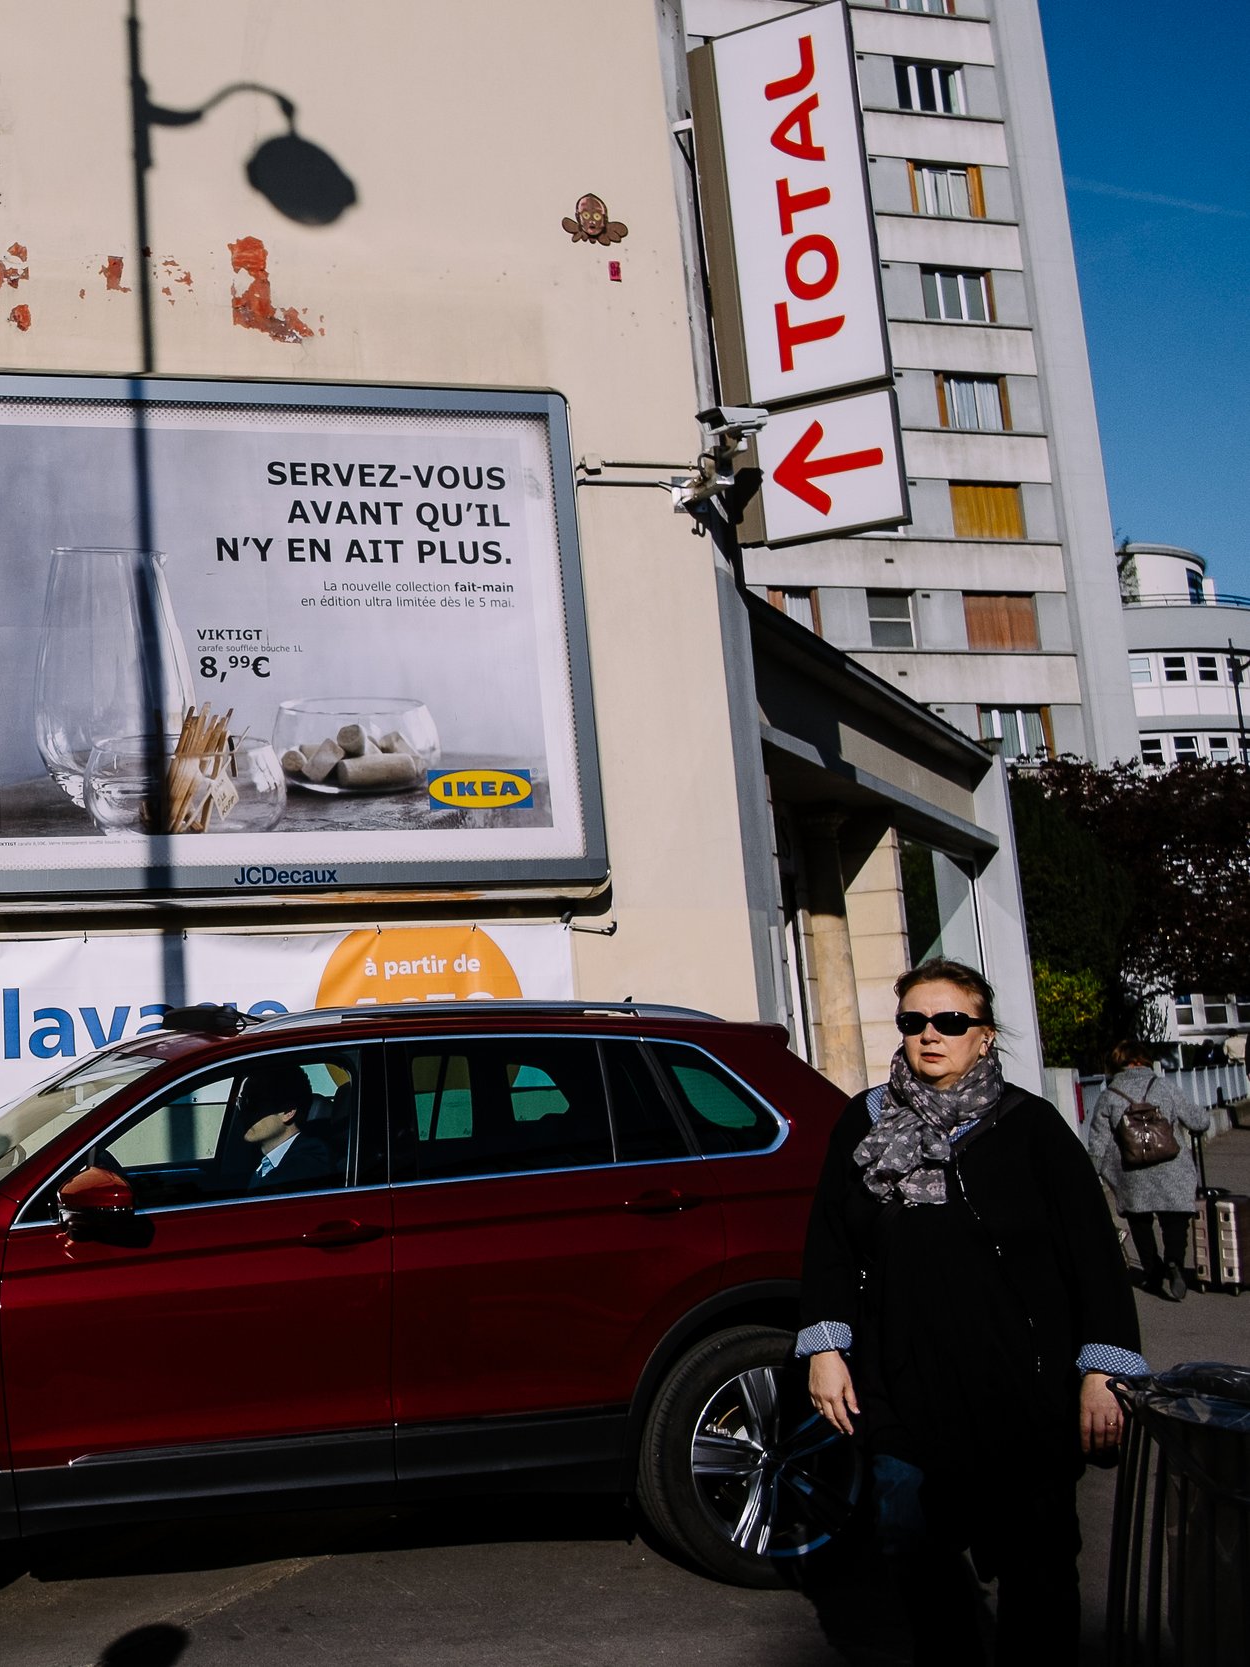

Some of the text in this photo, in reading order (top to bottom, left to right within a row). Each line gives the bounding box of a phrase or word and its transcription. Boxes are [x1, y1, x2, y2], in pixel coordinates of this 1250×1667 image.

[764, 34, 846, 373] TOTAL
[266, 461, 506, 490] SERVEZ-VOUS
[287, 500, 510, 532] AVANT QU'IL
[215, 537, 512, 565] N'Y EN AIT PLUS.
[323, 580, 514, 593] La nouvelle collection fait-main
[301, 595, 515, 608] en édition ultra limitée dès le 5 mai.
[196, 629, 263, 641] VIKTIGT
[197, 644, 224, 652] carafe
[226, 644, 259, 653] soufflée
[261, 644, 291, 653] bouche
[199, 655, 271, 683] 8,99€
[442, 781, 521, 797] IKEA
[234, 866, 338, 885] JCDecaux
[364, 954, 481, 981] à partir de
[2, 987, 291, 1060] lava
